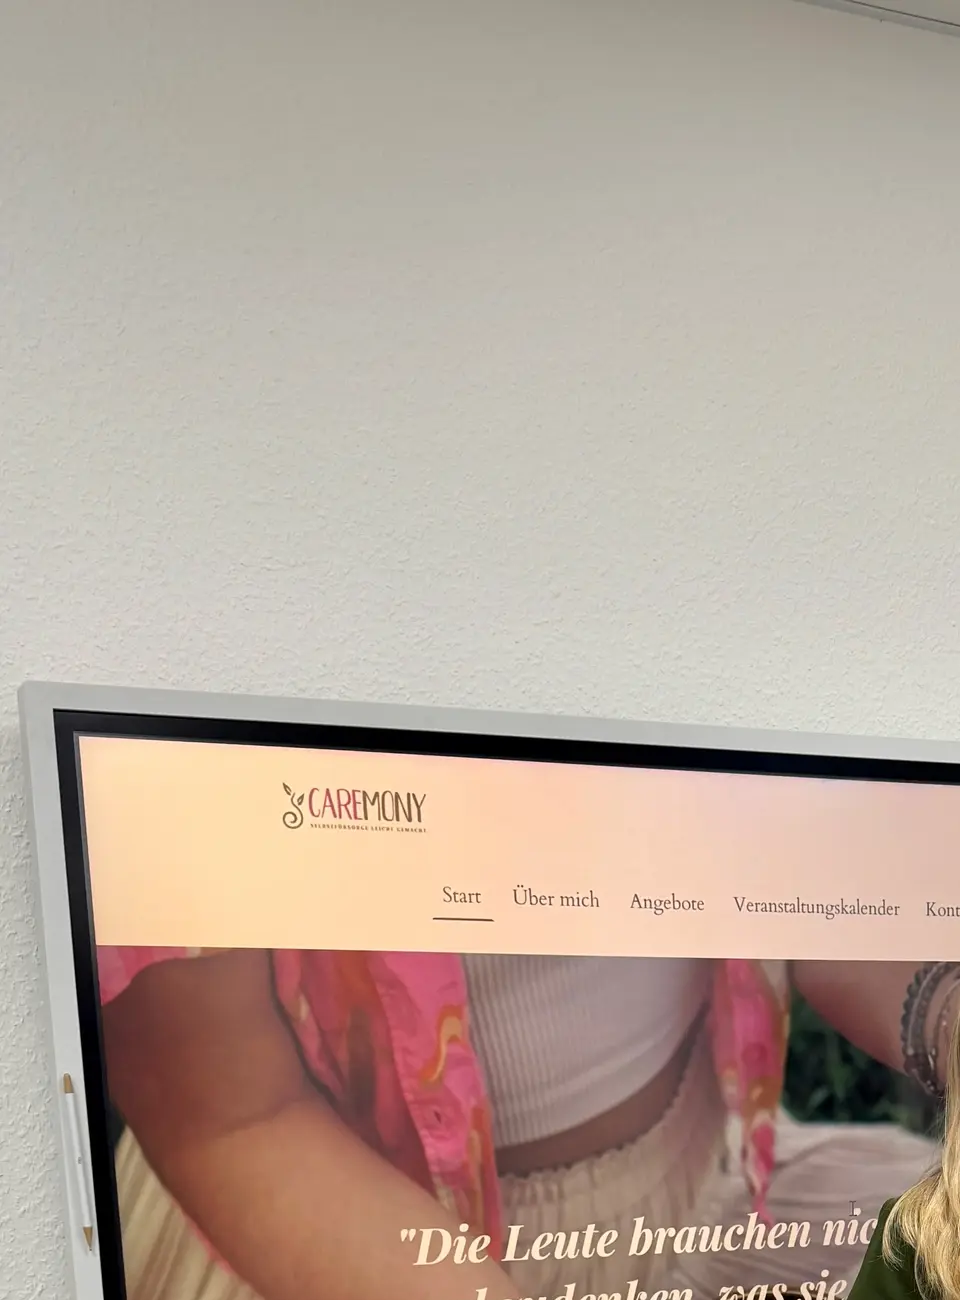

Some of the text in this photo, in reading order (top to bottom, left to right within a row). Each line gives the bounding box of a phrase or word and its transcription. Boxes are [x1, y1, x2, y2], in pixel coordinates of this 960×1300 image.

[308, 787, 427, 822] CAREMONY
[442, 886, 482, 904] Start
[512, 885, 600, 908] Über mich
[630, 893, 705, 916] Angebote
[733, 896, 900, 919] Veranstaltungskalender
[399, 1223, 491, 1266] "Die
[501, 1223, 618, 1262] Leute
[629, 1212, 811, 1255] brauchen
